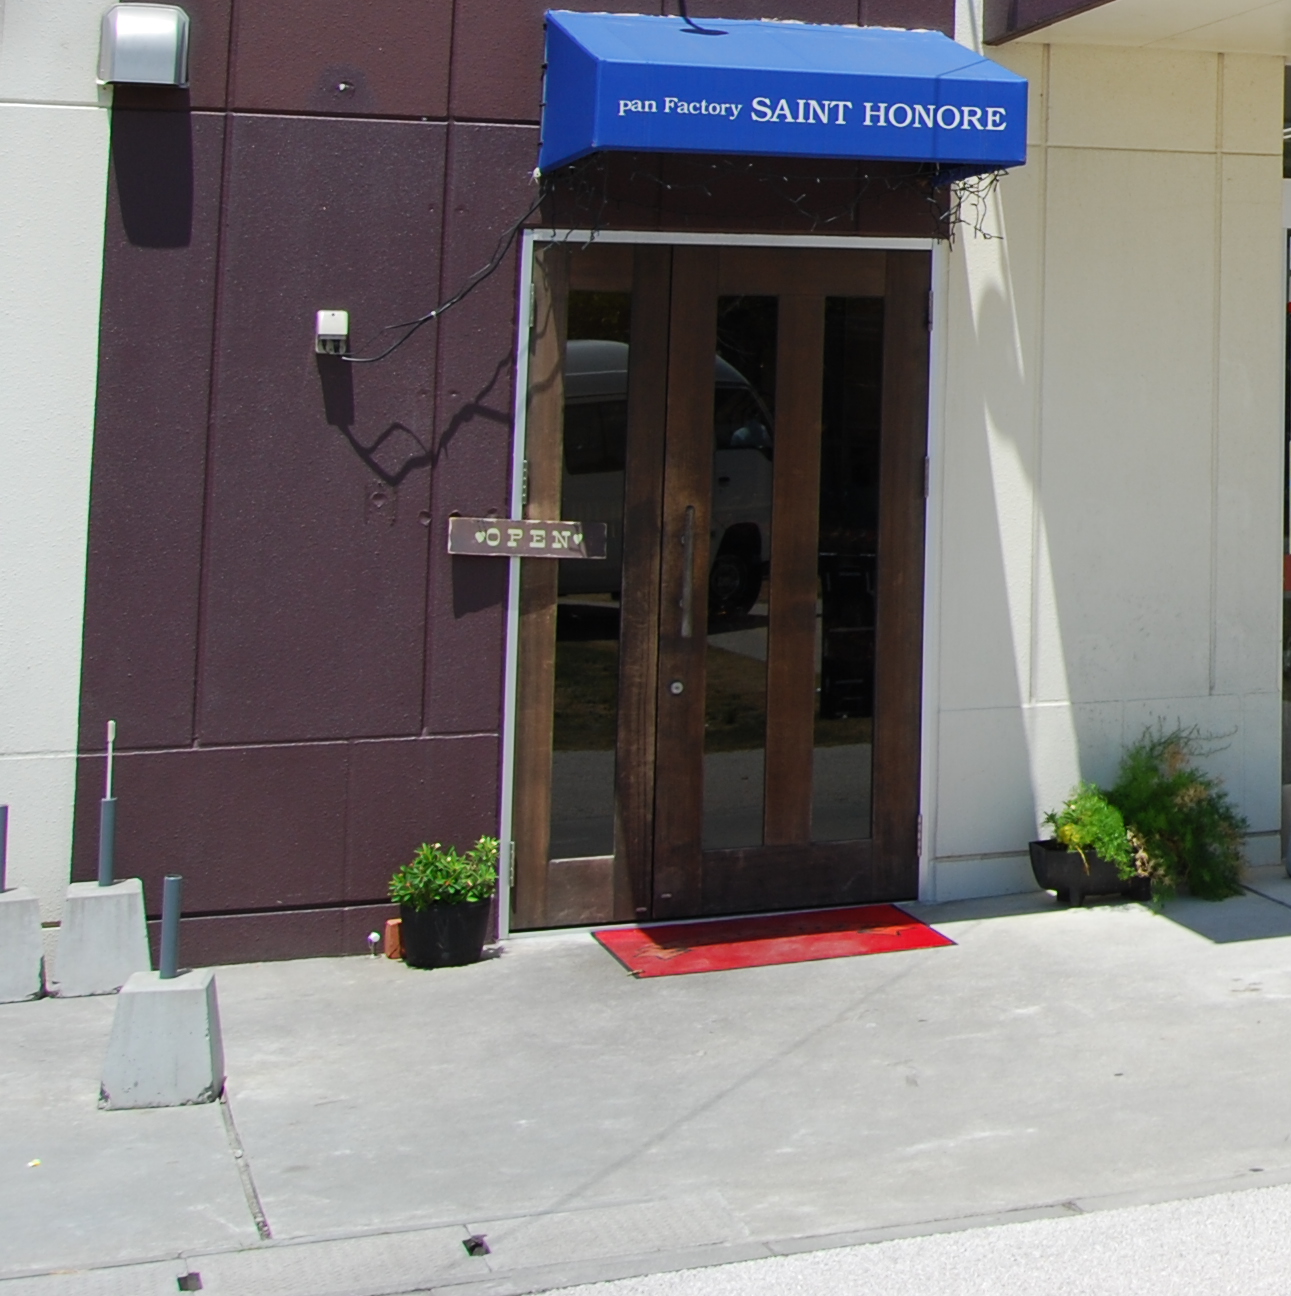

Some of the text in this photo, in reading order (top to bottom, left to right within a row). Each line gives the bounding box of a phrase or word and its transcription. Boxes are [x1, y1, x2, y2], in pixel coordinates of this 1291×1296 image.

[618, 96, 1007, 131] pan Factory SAINT HONORE
[486, 527, 571, 549] OPEN
